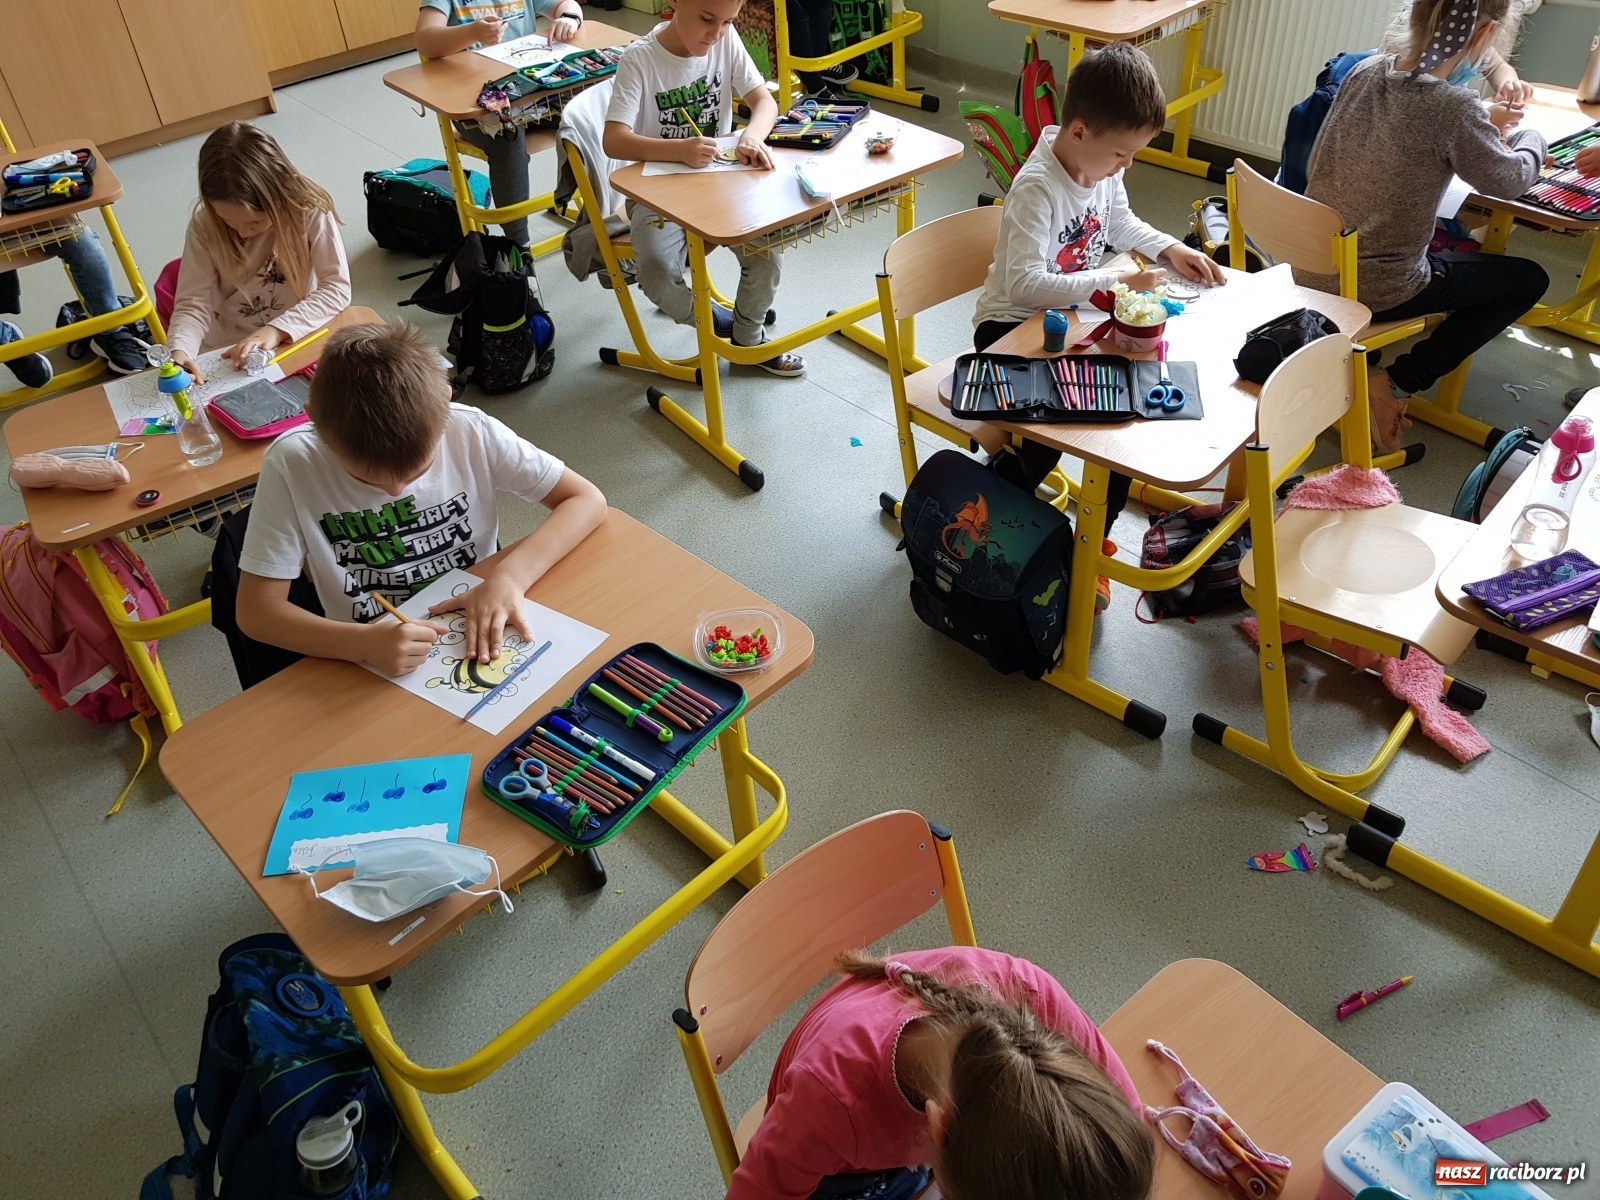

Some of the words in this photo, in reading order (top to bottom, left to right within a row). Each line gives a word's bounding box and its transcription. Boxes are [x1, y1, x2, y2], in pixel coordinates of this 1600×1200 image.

[655, 75, 709, 110] GAME
[321, 494, 421, 543] GAME
[344, 542, 476, 594] MINECRAFT
[357, 534, 407, 566] ON
